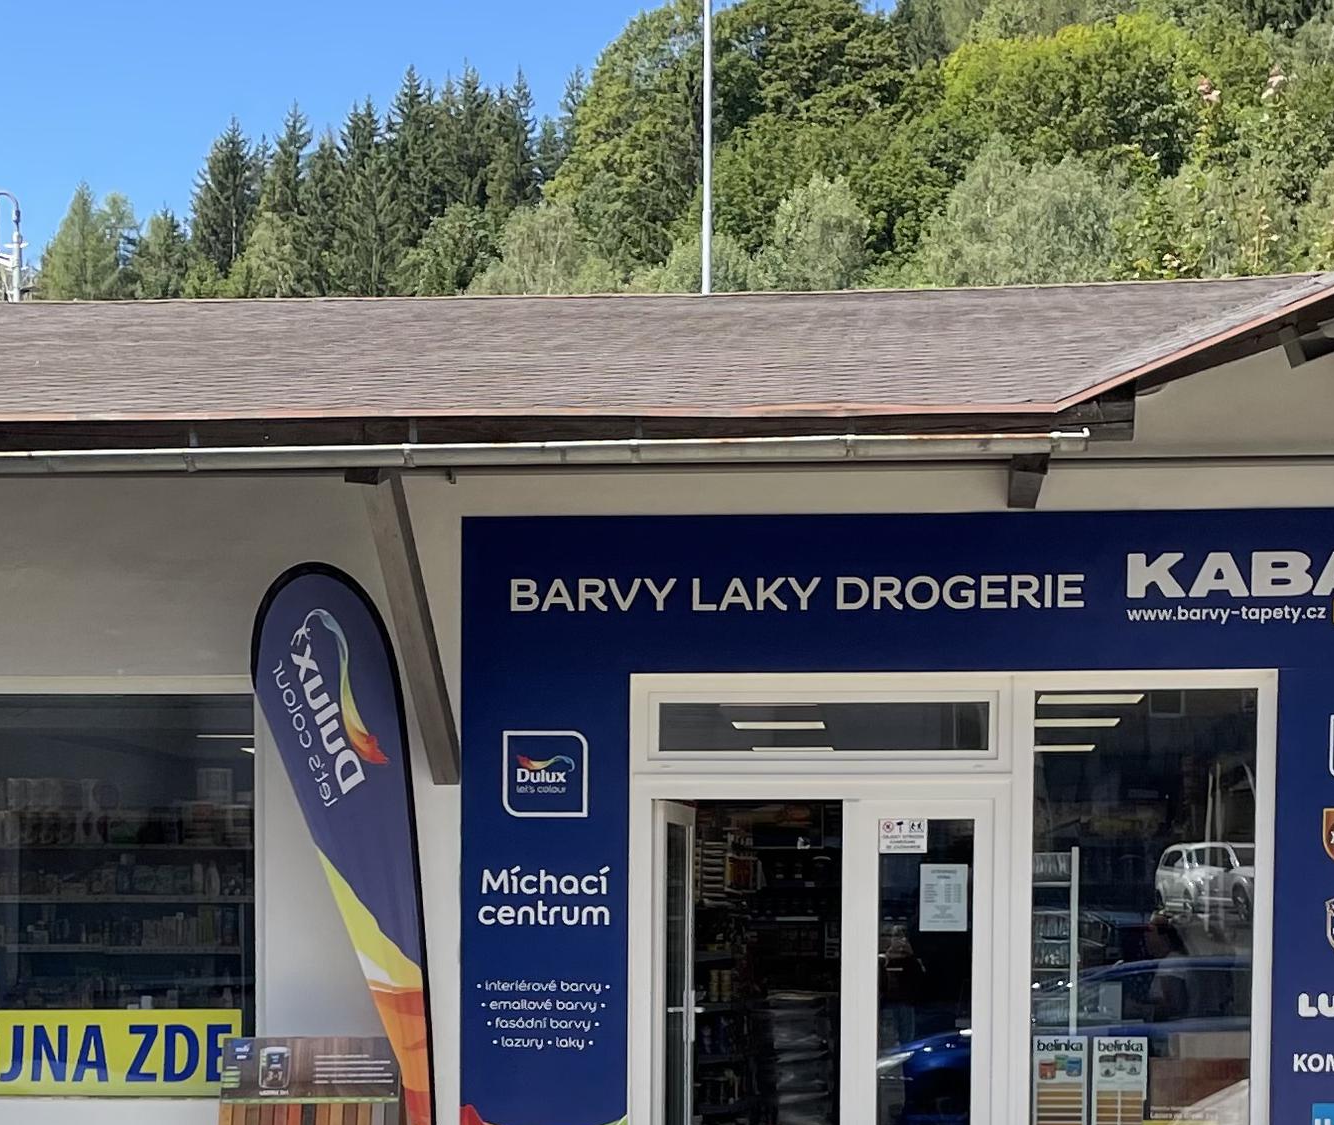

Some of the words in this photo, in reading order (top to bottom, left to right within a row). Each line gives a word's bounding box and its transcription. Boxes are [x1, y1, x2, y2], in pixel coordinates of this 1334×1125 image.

[510, 578, 677, 611] BARVY
[692, 577, 821, 611] LAKY
[836, 574, 1085, 609] DROGERIE
[1126, 605, 1327, 625] www.barvy-tapety.cz
[516, 768, 566, 783] Dulux
[481, 866, 610, 895] Míchací
[478, 900, 610, 926] centrum
[485, 980, 557, 993] interiérové
[560, 981, 602, 995] barvy
[489, 999, 552, 1012] emailové
[556, 1000, 597, 1013] barvy
[495, 1017, 547, 1029] fasádní
[550, 1018, 591, 1032] barvy
[501, 1036, 544, 1050] lazury
[556, 1037, 585, 1051] laky
[1036, 1039, 1083, 1052] belinka
[1098, 1039, 1144, 1052] belinka
